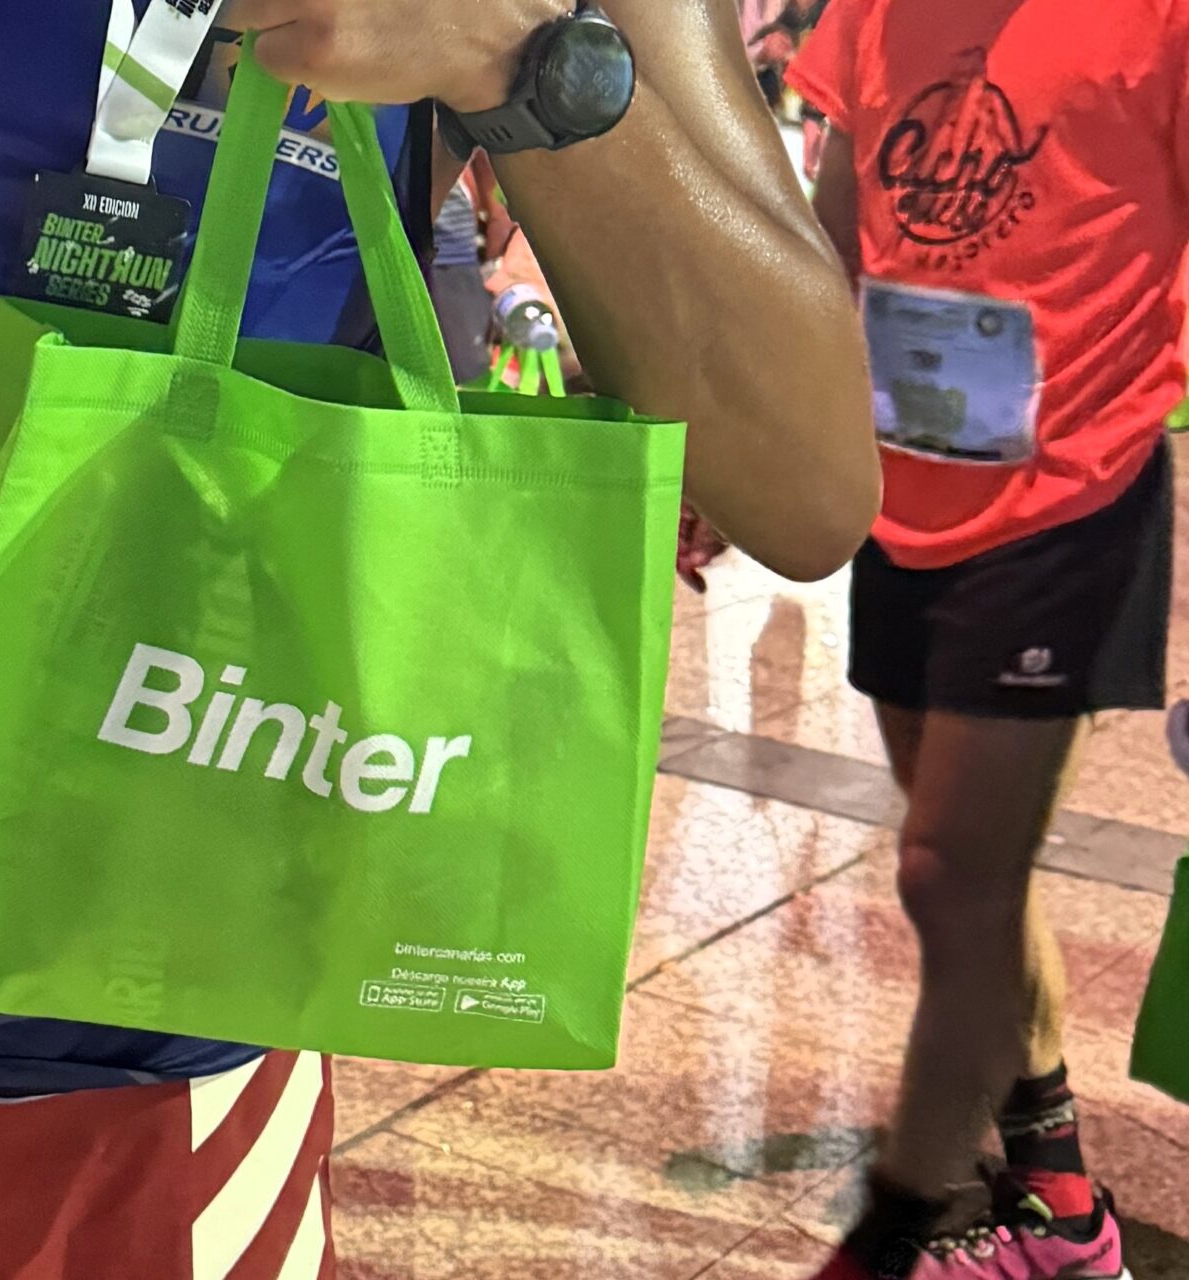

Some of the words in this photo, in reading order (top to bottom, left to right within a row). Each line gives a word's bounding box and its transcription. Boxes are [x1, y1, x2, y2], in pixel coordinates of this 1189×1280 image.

[83, 193, 97, 212] XII
[42, 212, 105, 242] BINTER
[34, 235, 173, 290] NIGHTRUN
[46, 274, 110, 306] SERIES
[97, 642, 473, 814] Binter
[499, 976, 526, 992] App
[381, 993, 407, 1006] App
